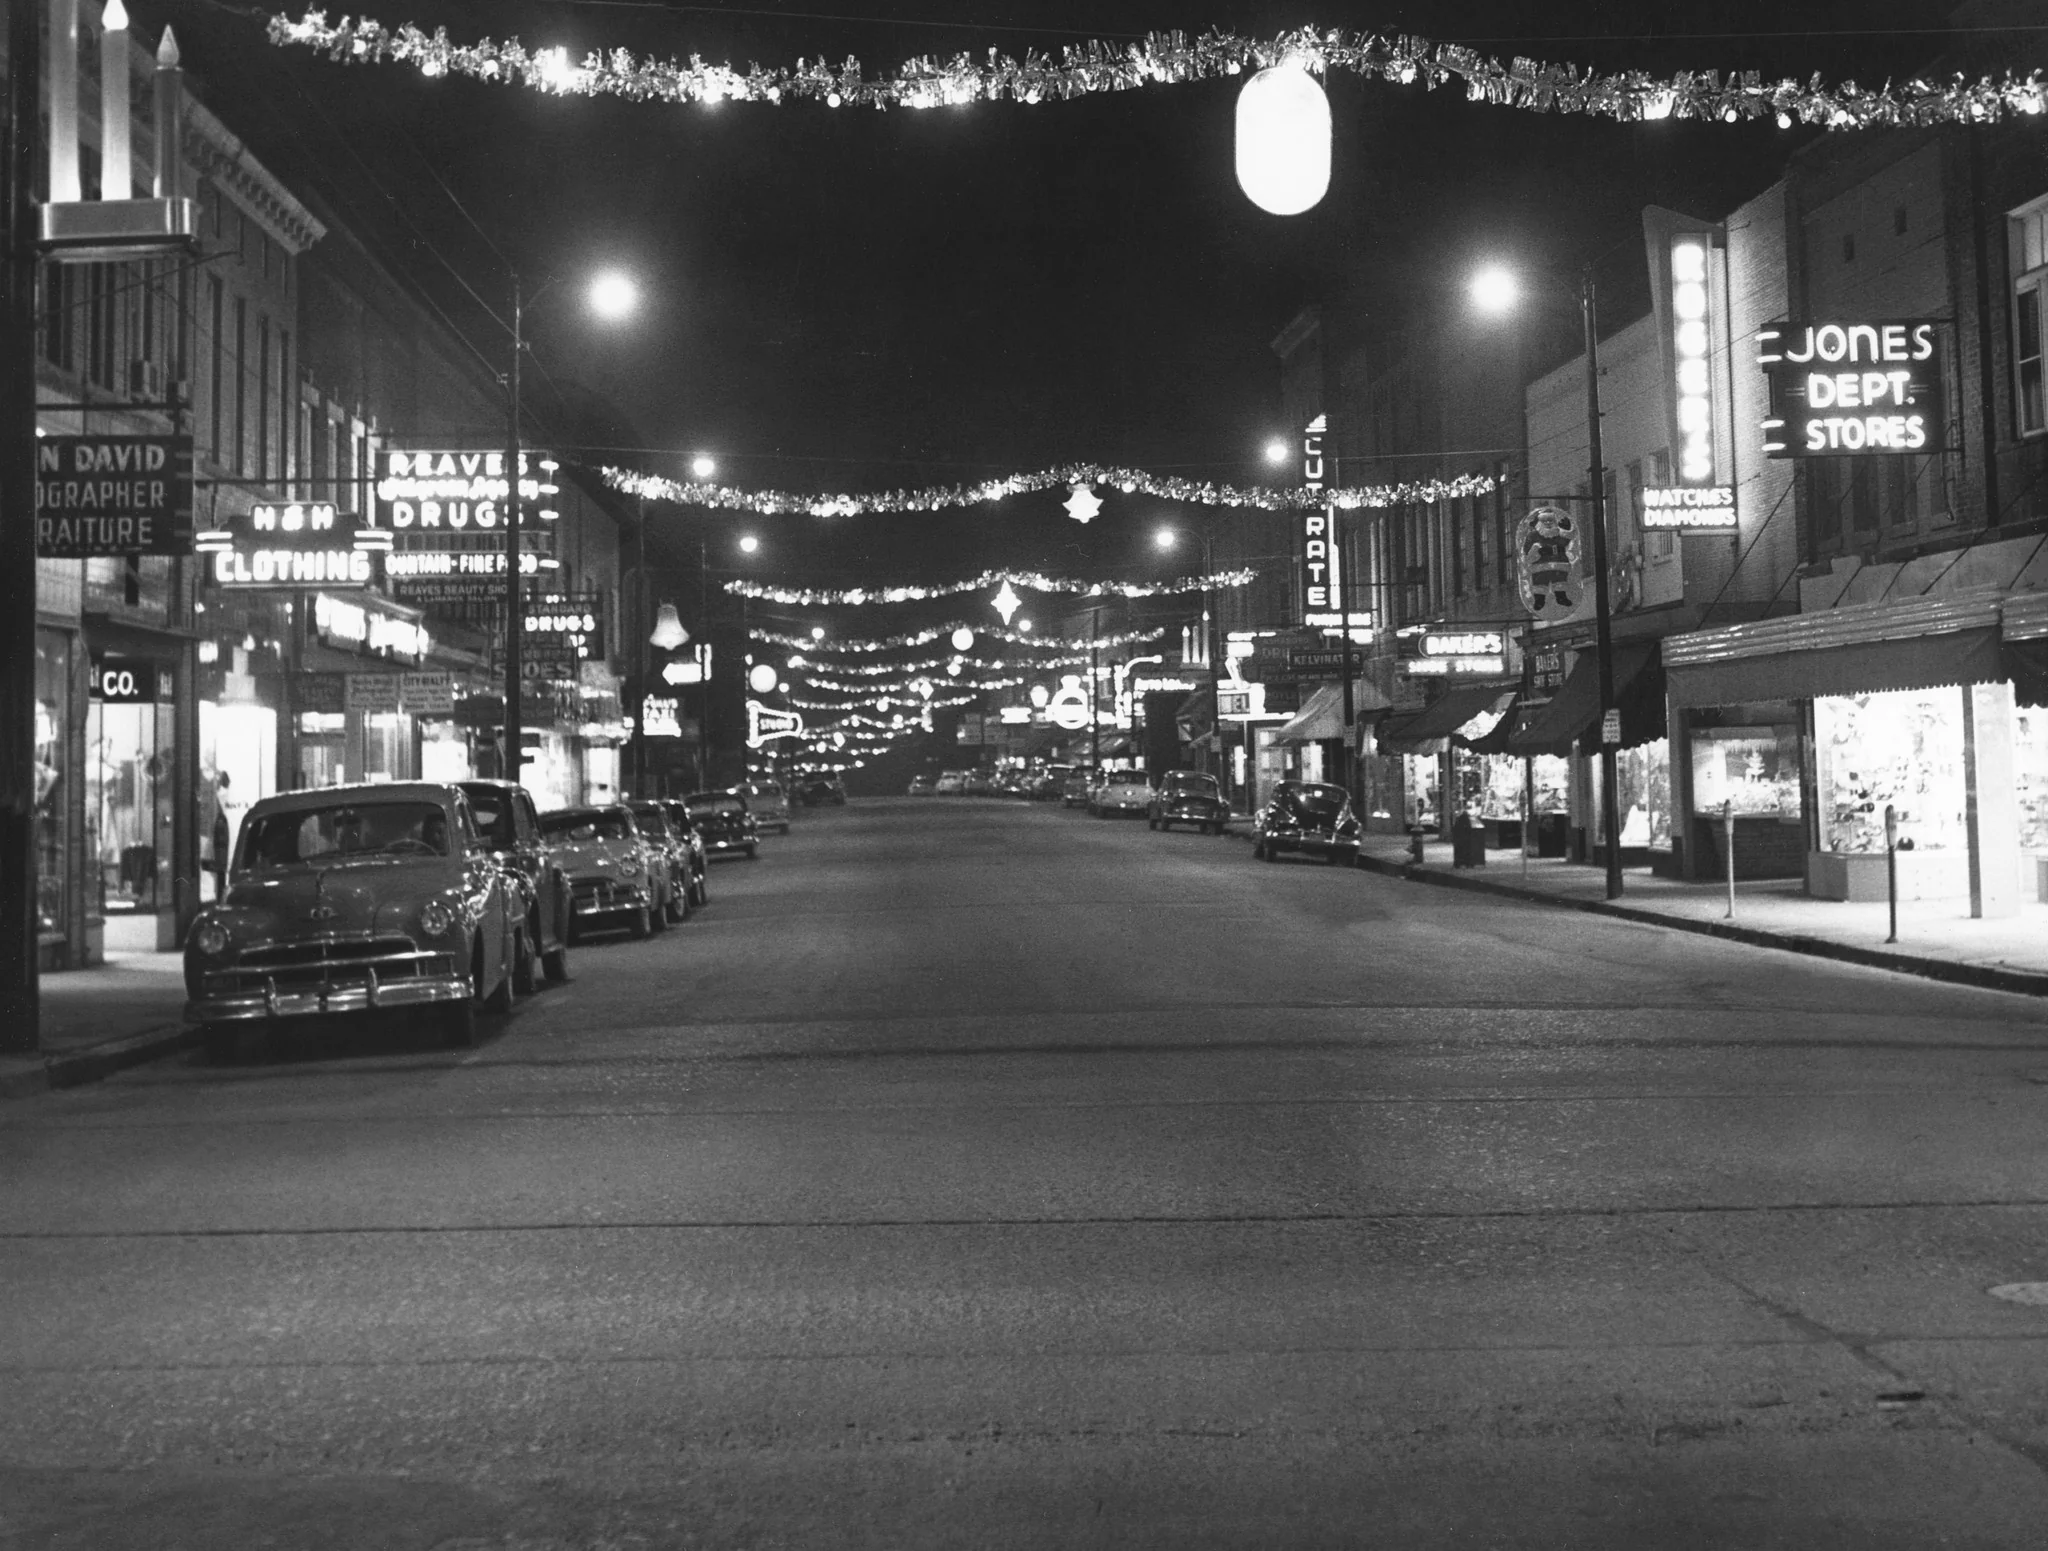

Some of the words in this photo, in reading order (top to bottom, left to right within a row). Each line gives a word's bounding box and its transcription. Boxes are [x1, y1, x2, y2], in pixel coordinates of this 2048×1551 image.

[1786, 325, 1932, 362] JONES
[1808, 371, 1915, 408] DEPT.
[1806, 416, 1925, 450] STORES
[75, 444, 164, 472] DAVID
[1305, 436, 1323, 498] CUT
[1643, 488, 1733, 506] WATCHES
[253, 506, 275, 530] H
[282, 505, 303, 530] &
[312, 506, 333, 530] H
[1644, 508, 1736, 526] DIAMONDS
[38, 518, 152, 545] RAITURE
[215, 551, 370, 581] CLOTHING
[385, 554, 451, 574] OUNTAIN
[460, 555, 494, 573] FINE
[496, 553, 537, 573] FOD
[1306, 517, 1326, 606] RATE
[399, 585, 441, 595] REAVES
[444, 584, 485, 594] BEAUTY
[487, 584, 507, 594] SHO
[528, 603, 592, 614] STANDARD
[524, 614, 596, 632] DRUGS
[1427, 634, 1502, 654] BAKER'S
[493, 661, 573, 679] SOES
[1293, 653, 1361, 665] KELVINATR
[102, 671, 139, 696] CO.
